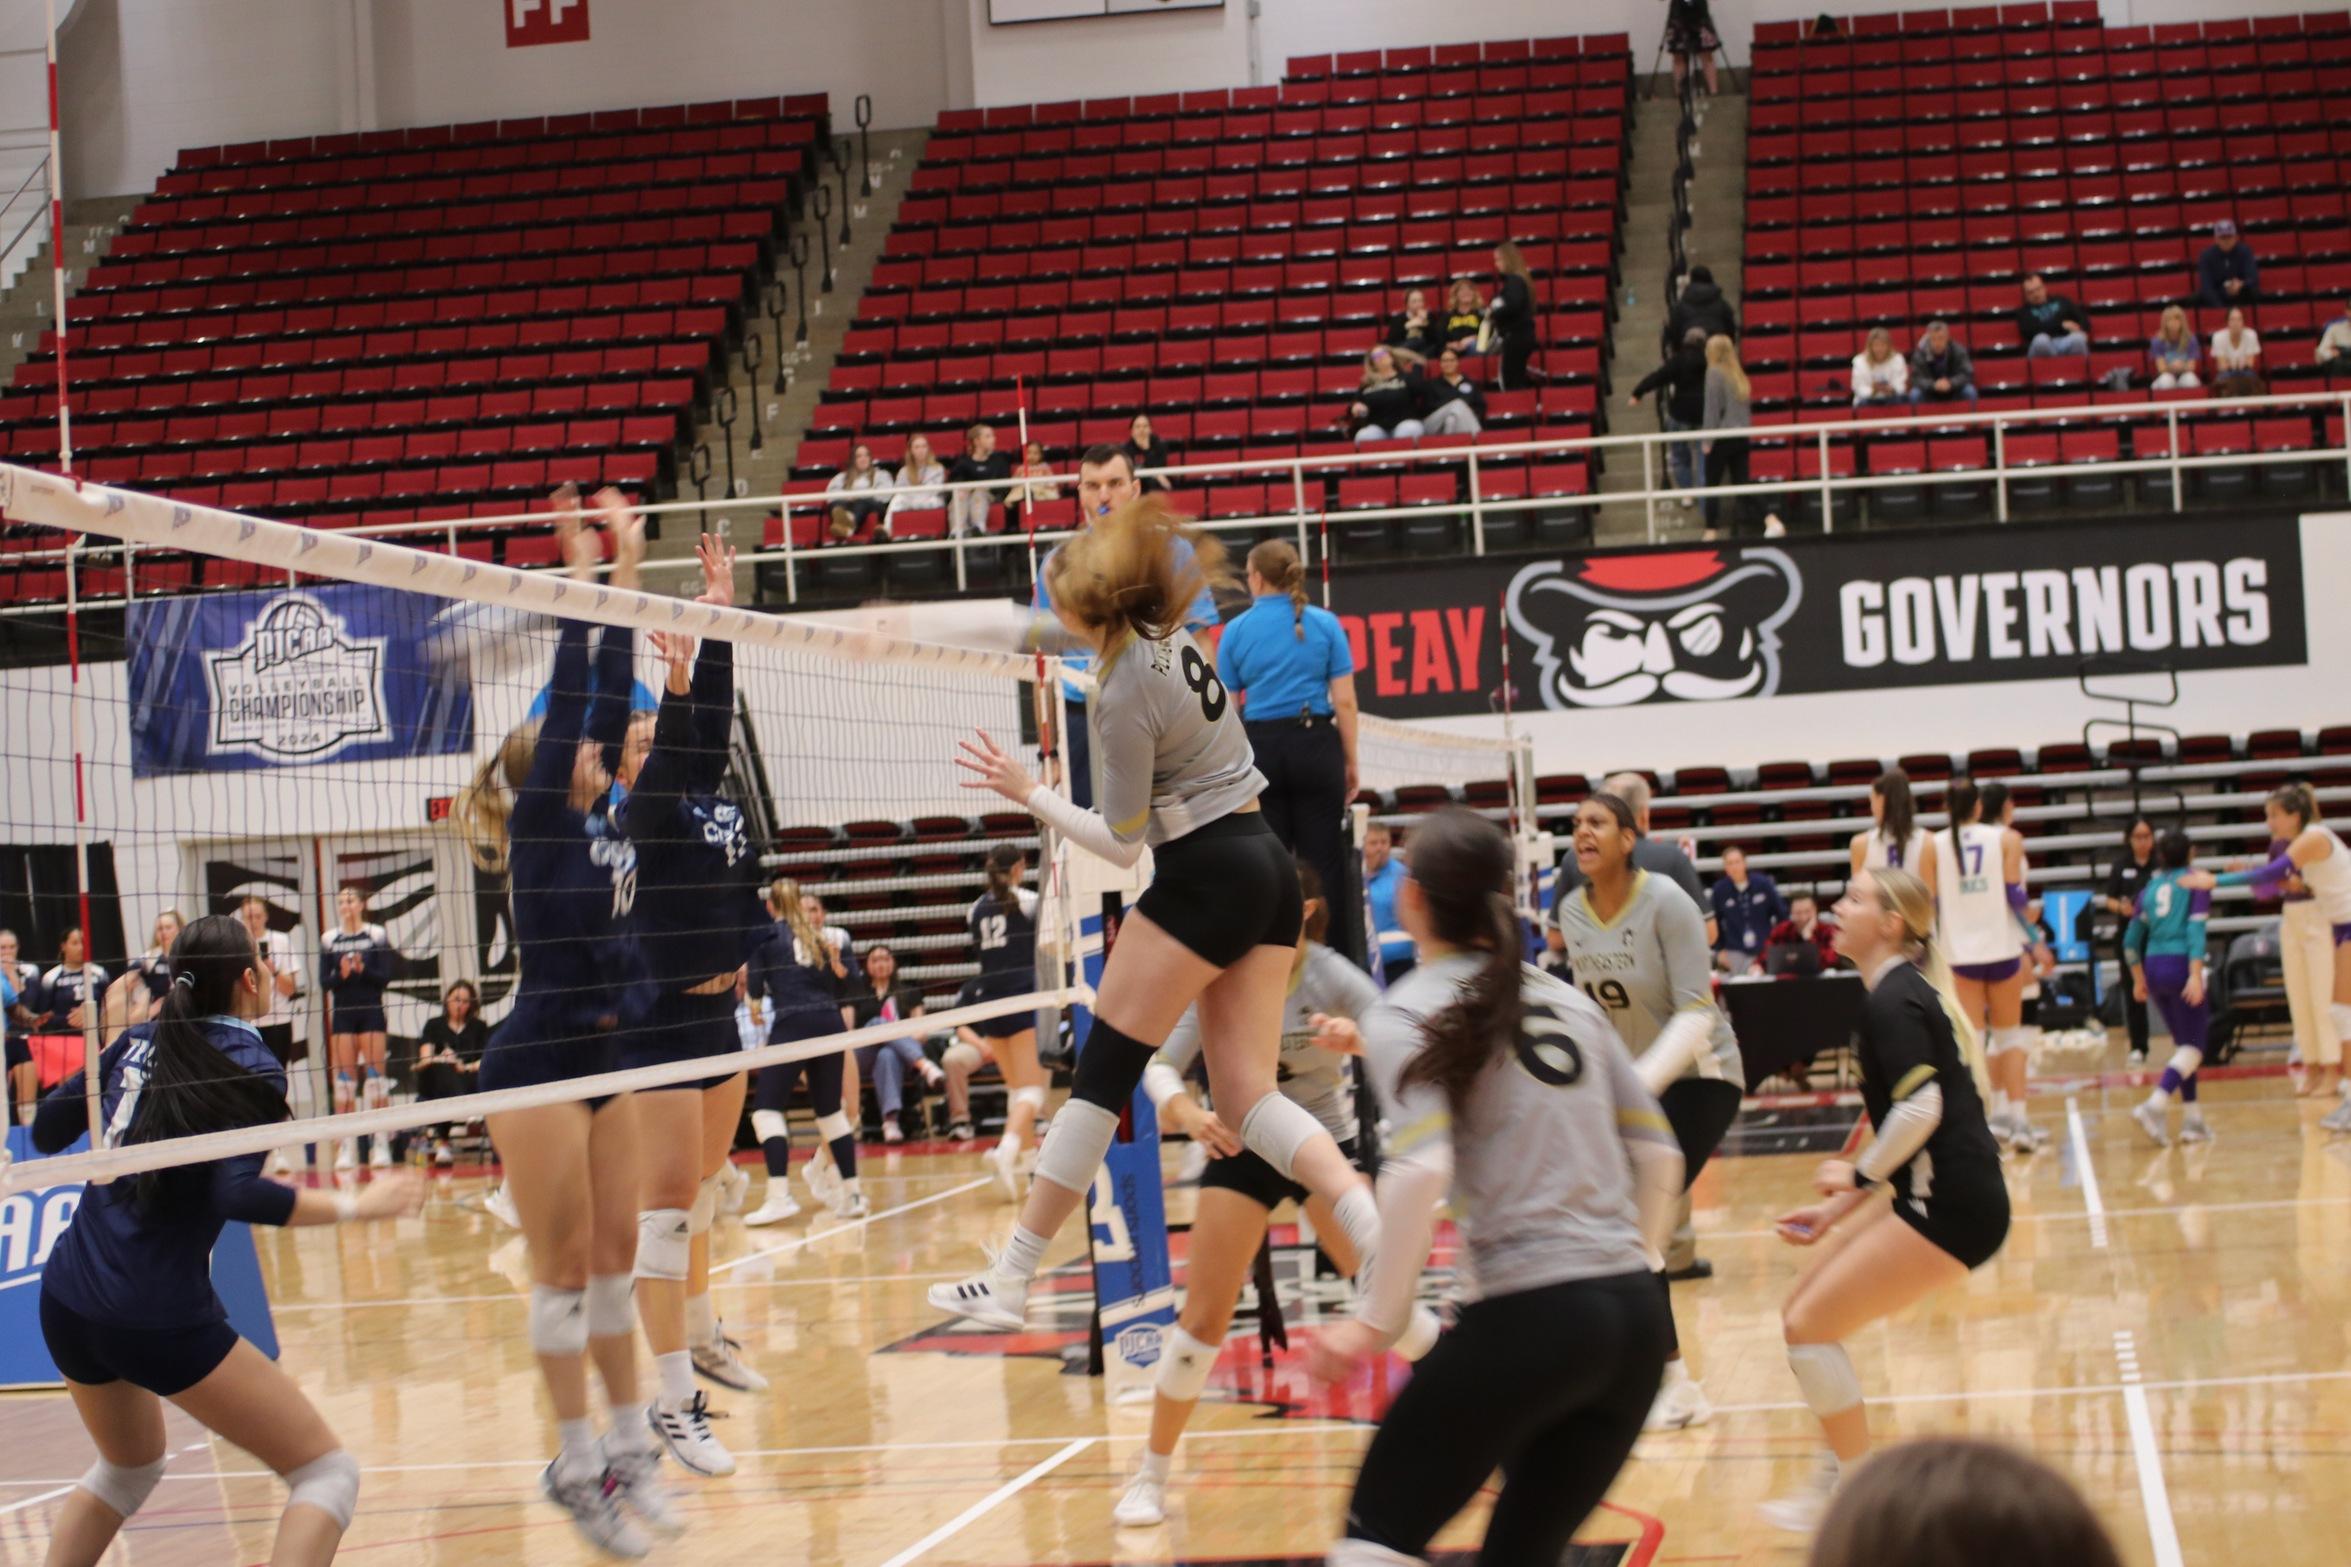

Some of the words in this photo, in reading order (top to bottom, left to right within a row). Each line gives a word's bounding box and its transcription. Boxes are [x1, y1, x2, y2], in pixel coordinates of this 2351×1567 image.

[1839, 557, 2271, 667] GOVERNORS
[1338, 606, 1486, 697] PEAY
[229, 676, 364, 695] VOLLEYBALL
[1181, 645, 1226, 722] 8
[230, 690, 365, 722] CHAMPIONSHIP
[278, 731, 321, 746] 2024
[2155, 883, 2173, 918] 9
[979, 914, 1008, 951] 12
[1584, 979, 1631, 1012] 19
[1512, 1004, 1583, 1086] 6
